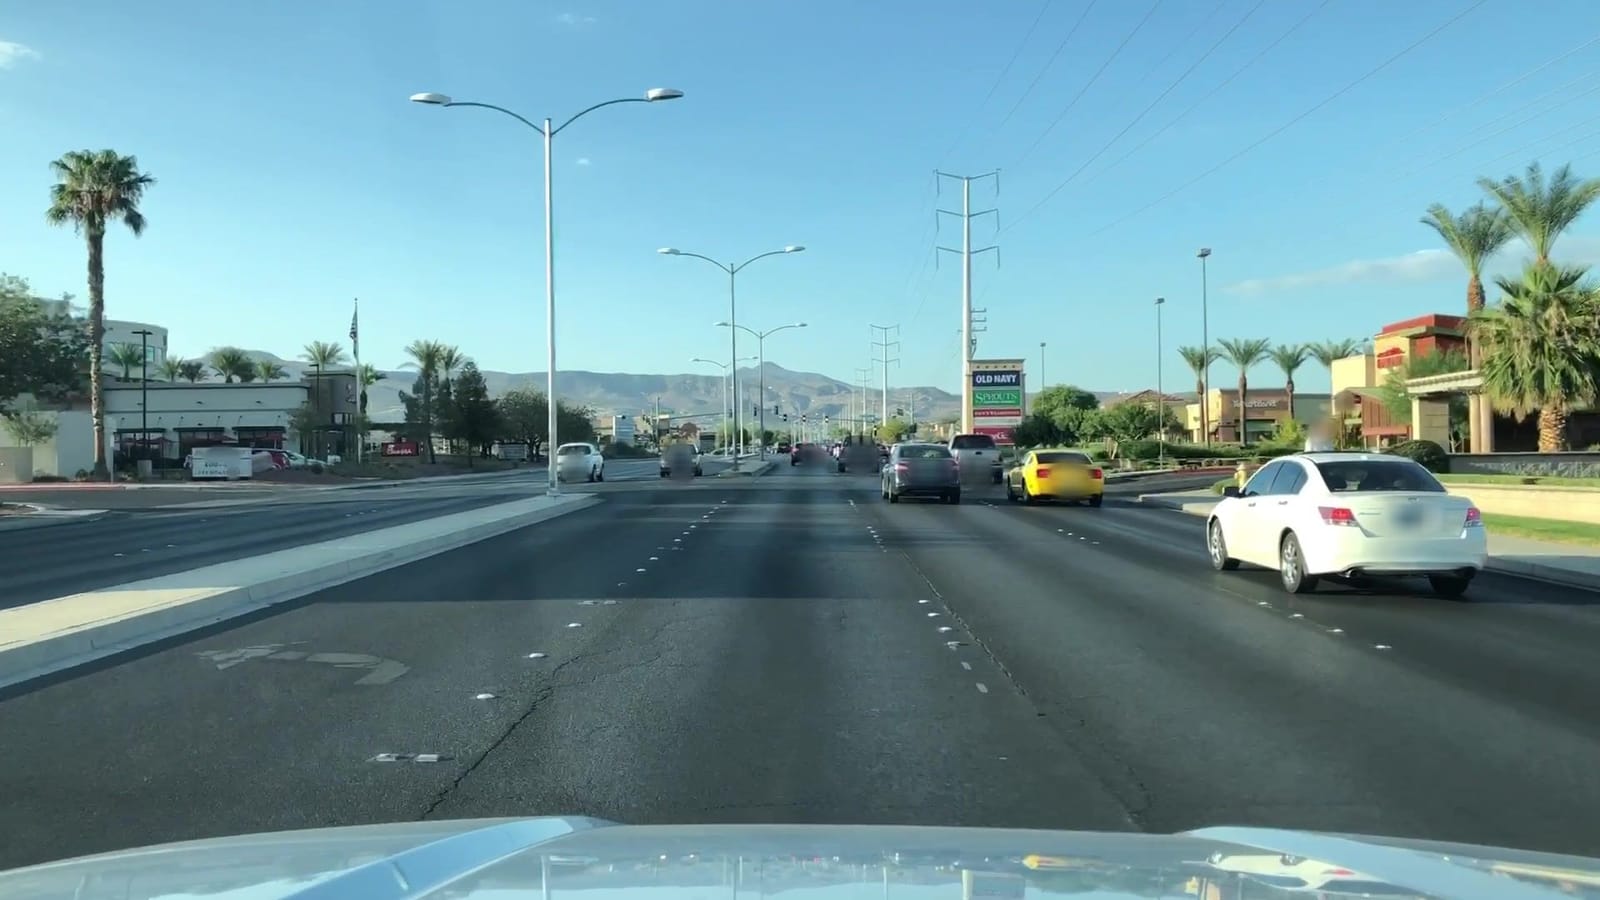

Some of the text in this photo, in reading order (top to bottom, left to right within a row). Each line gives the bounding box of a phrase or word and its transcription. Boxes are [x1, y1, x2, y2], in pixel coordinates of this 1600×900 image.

[975, 374, 1017, 384] OLD NAVY
[975, 391, 1018, 403] SPROUTS
